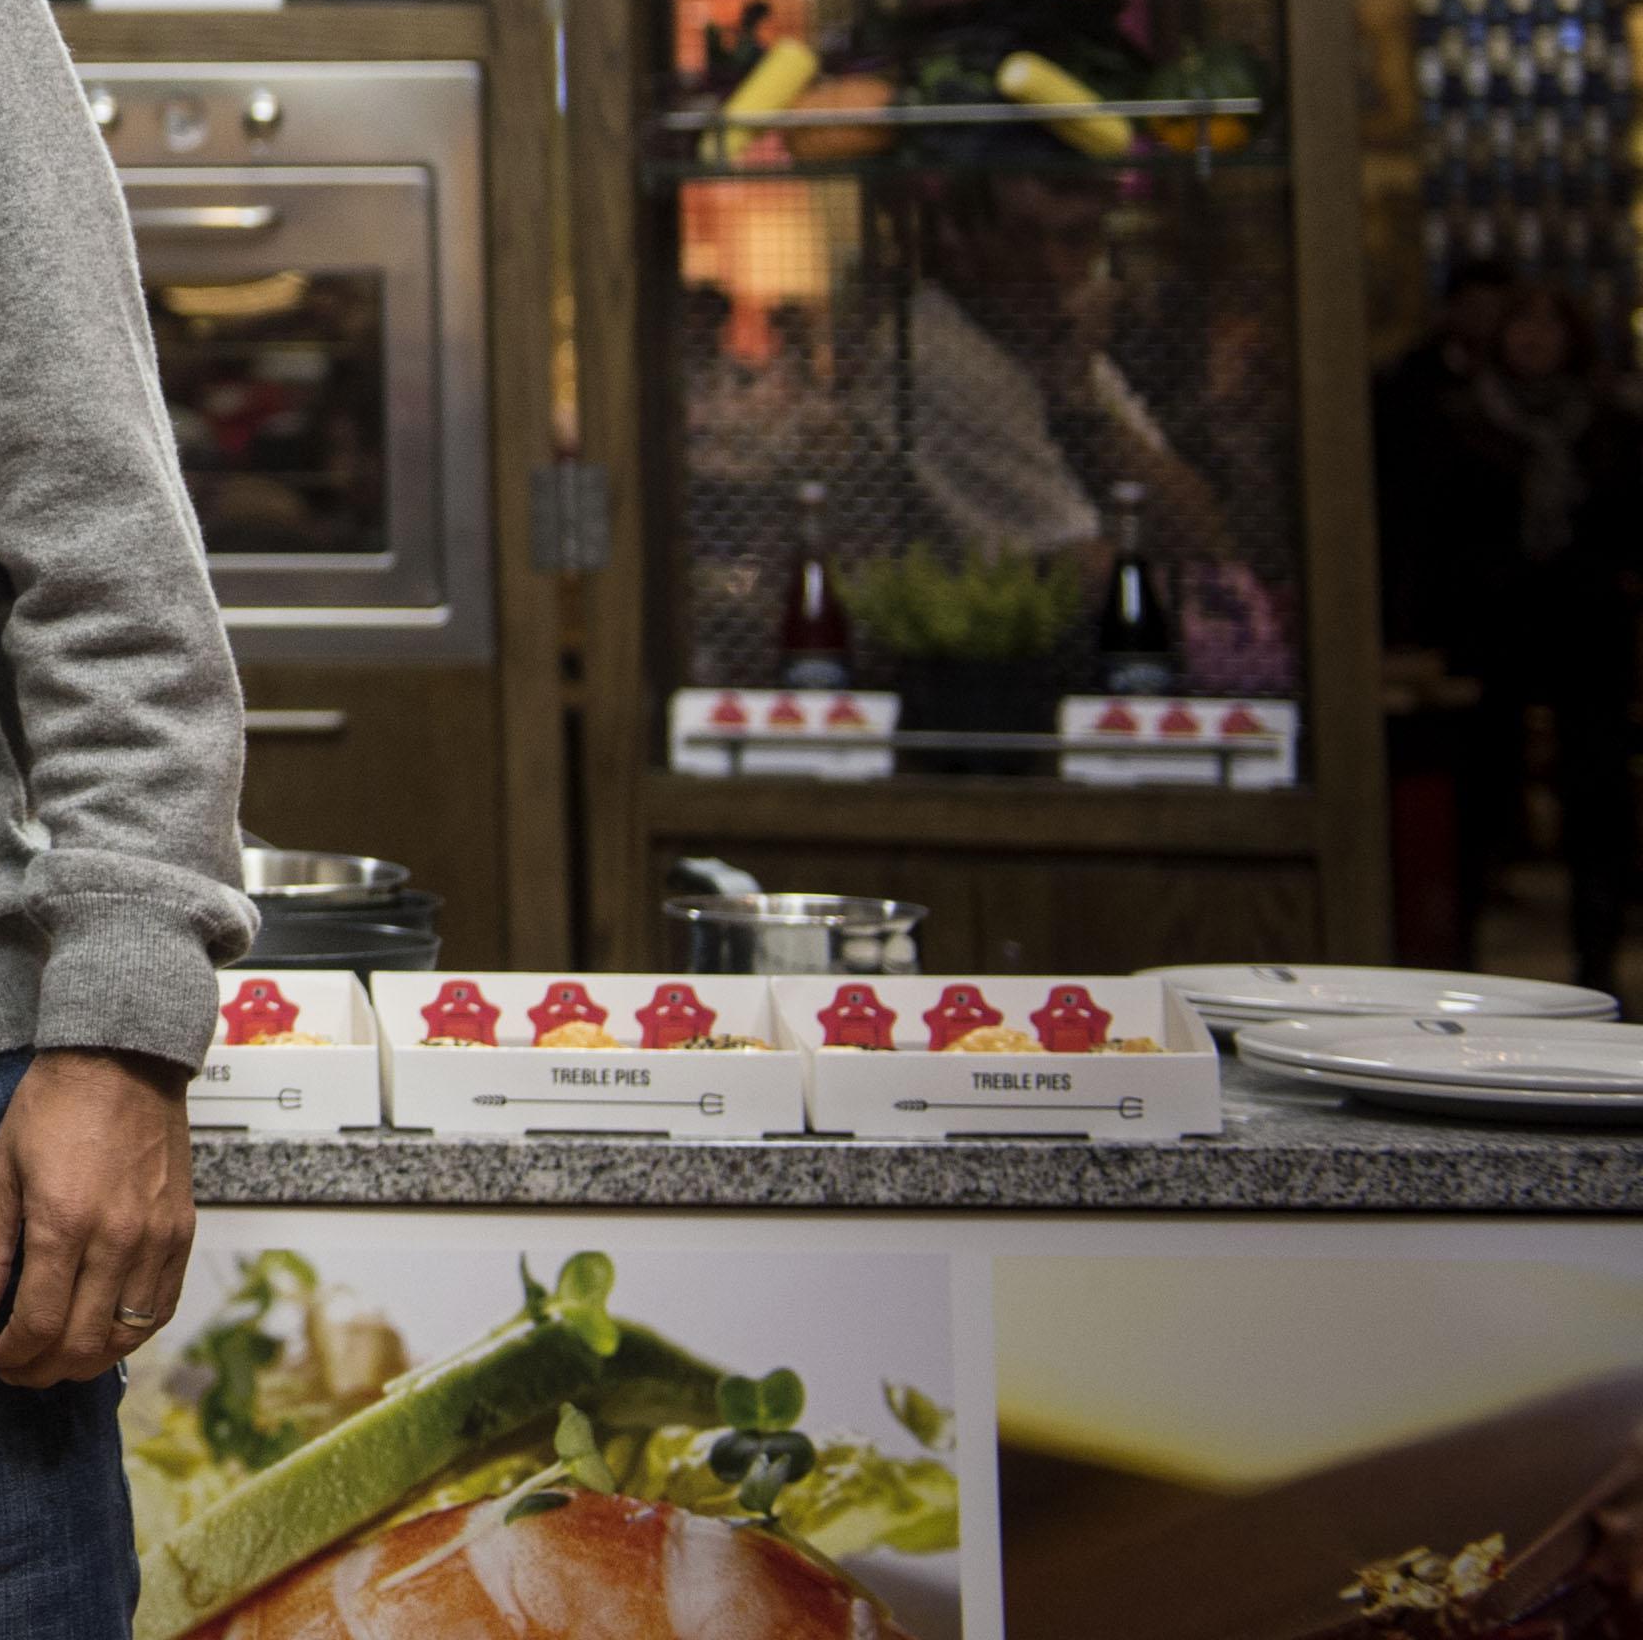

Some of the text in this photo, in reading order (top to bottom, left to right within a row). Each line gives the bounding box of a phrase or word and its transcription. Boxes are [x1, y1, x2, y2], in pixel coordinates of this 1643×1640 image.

[202, 1065, 231, 1082] IES
[551, 1067, 651, 1087] TREBLE PIES
[972, 1071, 1072, 1092] TREBLE PIES
